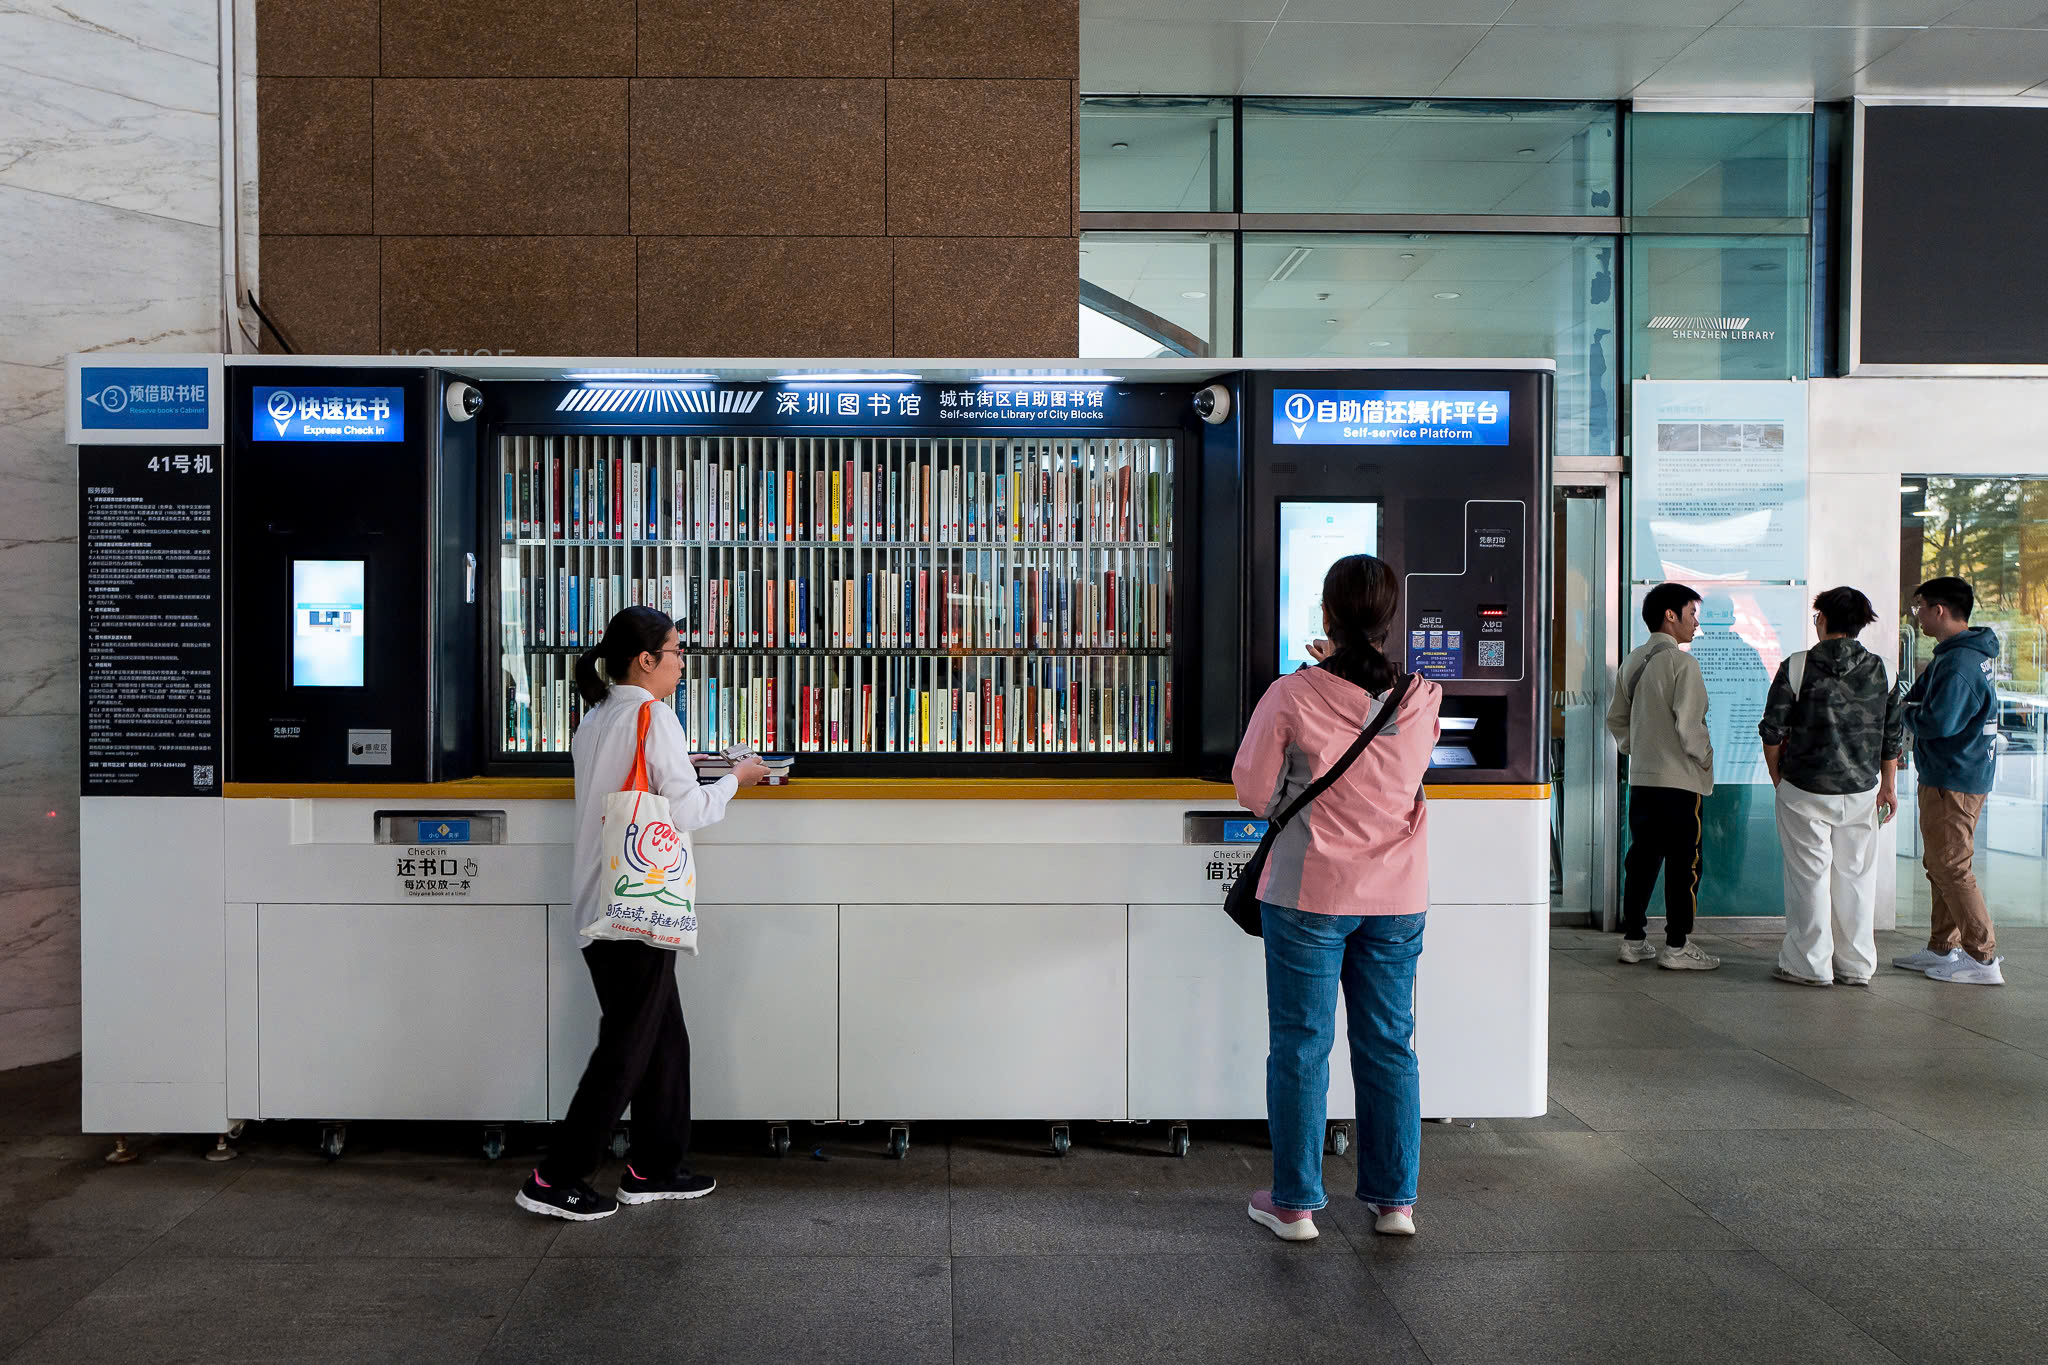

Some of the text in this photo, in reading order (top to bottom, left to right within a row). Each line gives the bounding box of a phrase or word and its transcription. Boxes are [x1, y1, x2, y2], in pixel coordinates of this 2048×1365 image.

[1672, 330, 1775, 340] SHENZHEN LIBRARY
[130, 385, 205, 402] 预借取书柜
[940, 390, 1104, 408] 城市街区自助图书馆
[299, 396, 390, 420] 快速还书
[776, 392, 922, 417] 深圳图书馆
[1316, 400, 1498, 424] 自助借还操作平台
[940, 410, 1104, 421] Self-service Library of City Blocks
[304, 425, 342, 436] Express
[344, 425, 374, 434] Check
[1343, 427, 1472, 438] Self-service Platform
[148, 454, 214, 474] 41号机
[397, 858, 457, 876] 还书口
[405, 880, 470, 890] 每次仅放一本
